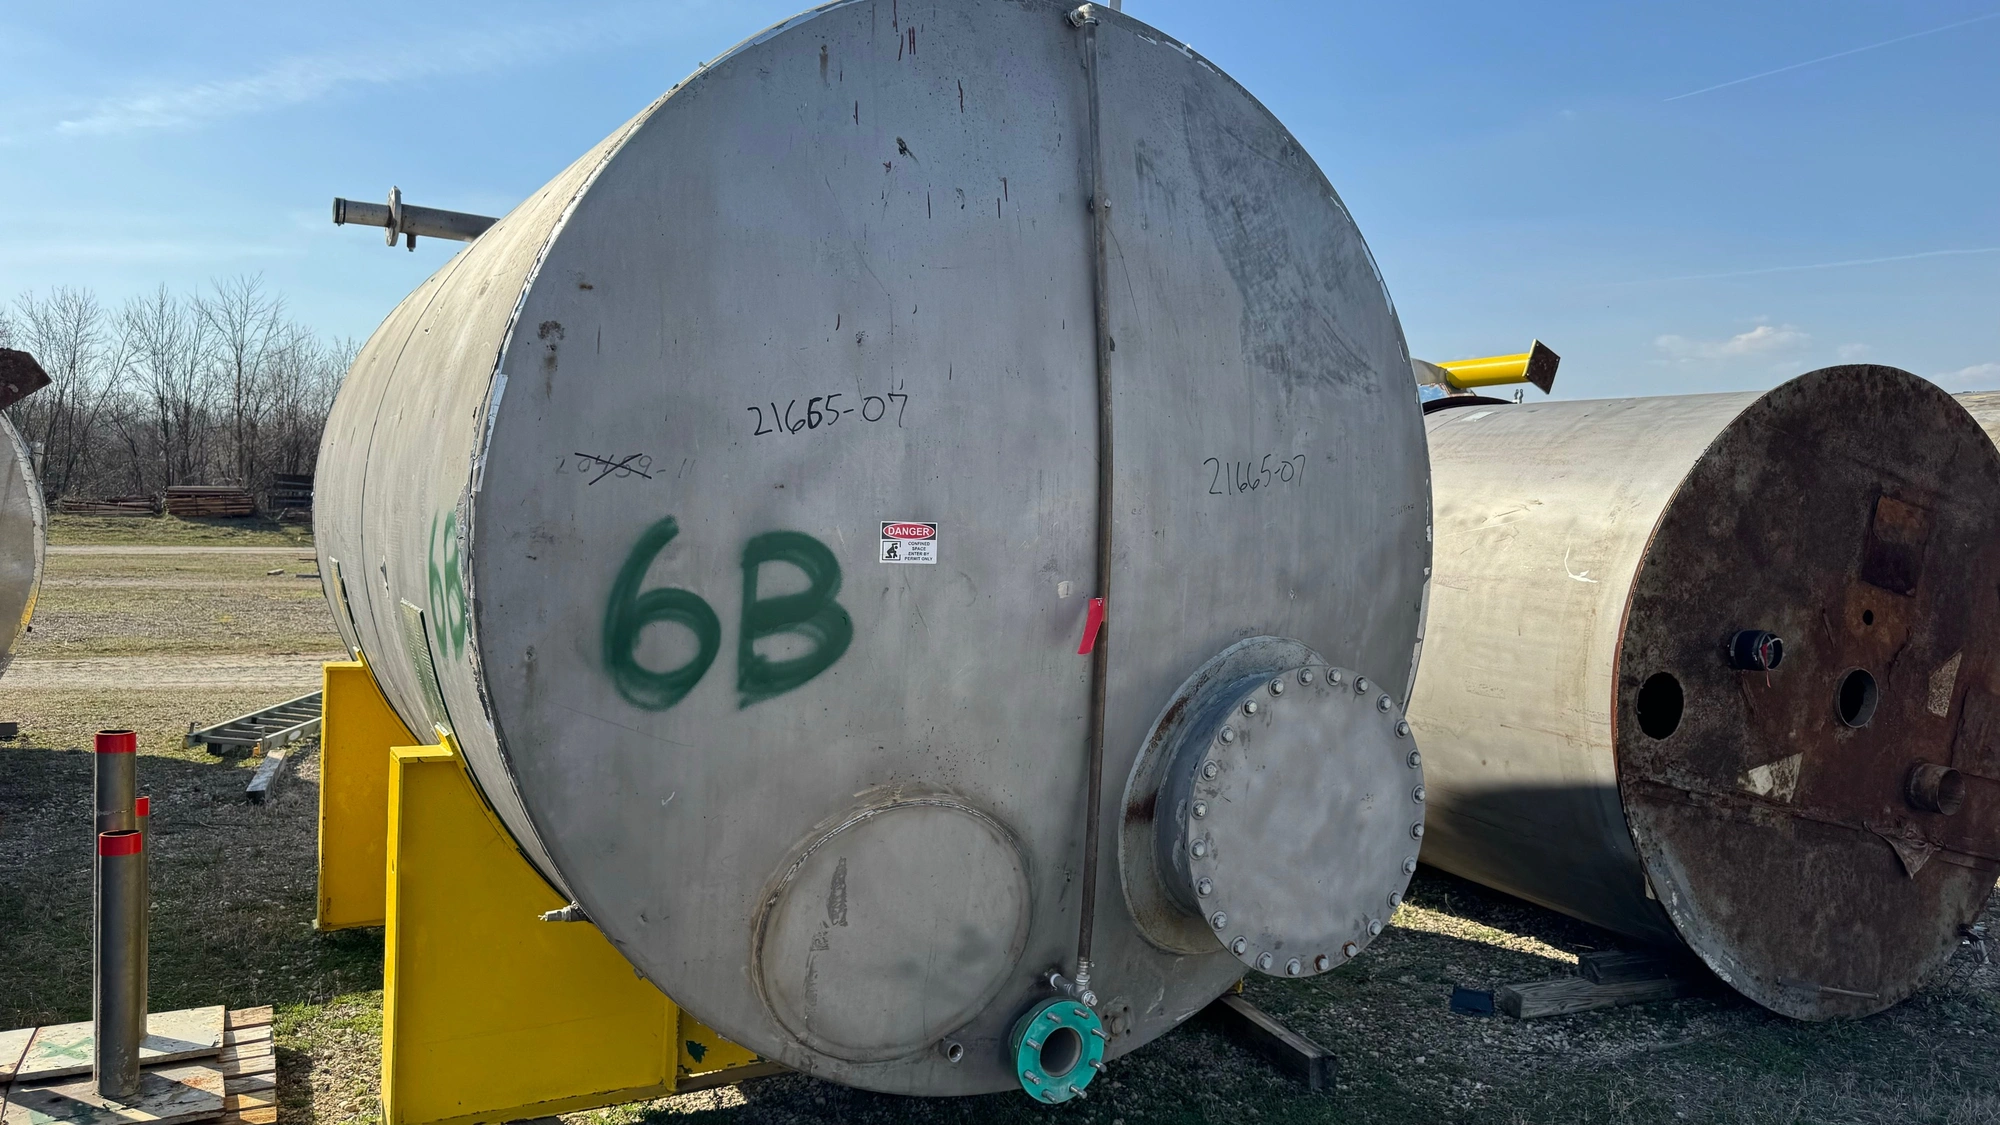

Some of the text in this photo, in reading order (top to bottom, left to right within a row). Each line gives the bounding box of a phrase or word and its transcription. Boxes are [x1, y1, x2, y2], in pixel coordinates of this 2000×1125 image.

[747, 393, 908, 436] 21665-07
[888, 526, 930, 536] DANGER
[603, 514, 854, 712] 6B
